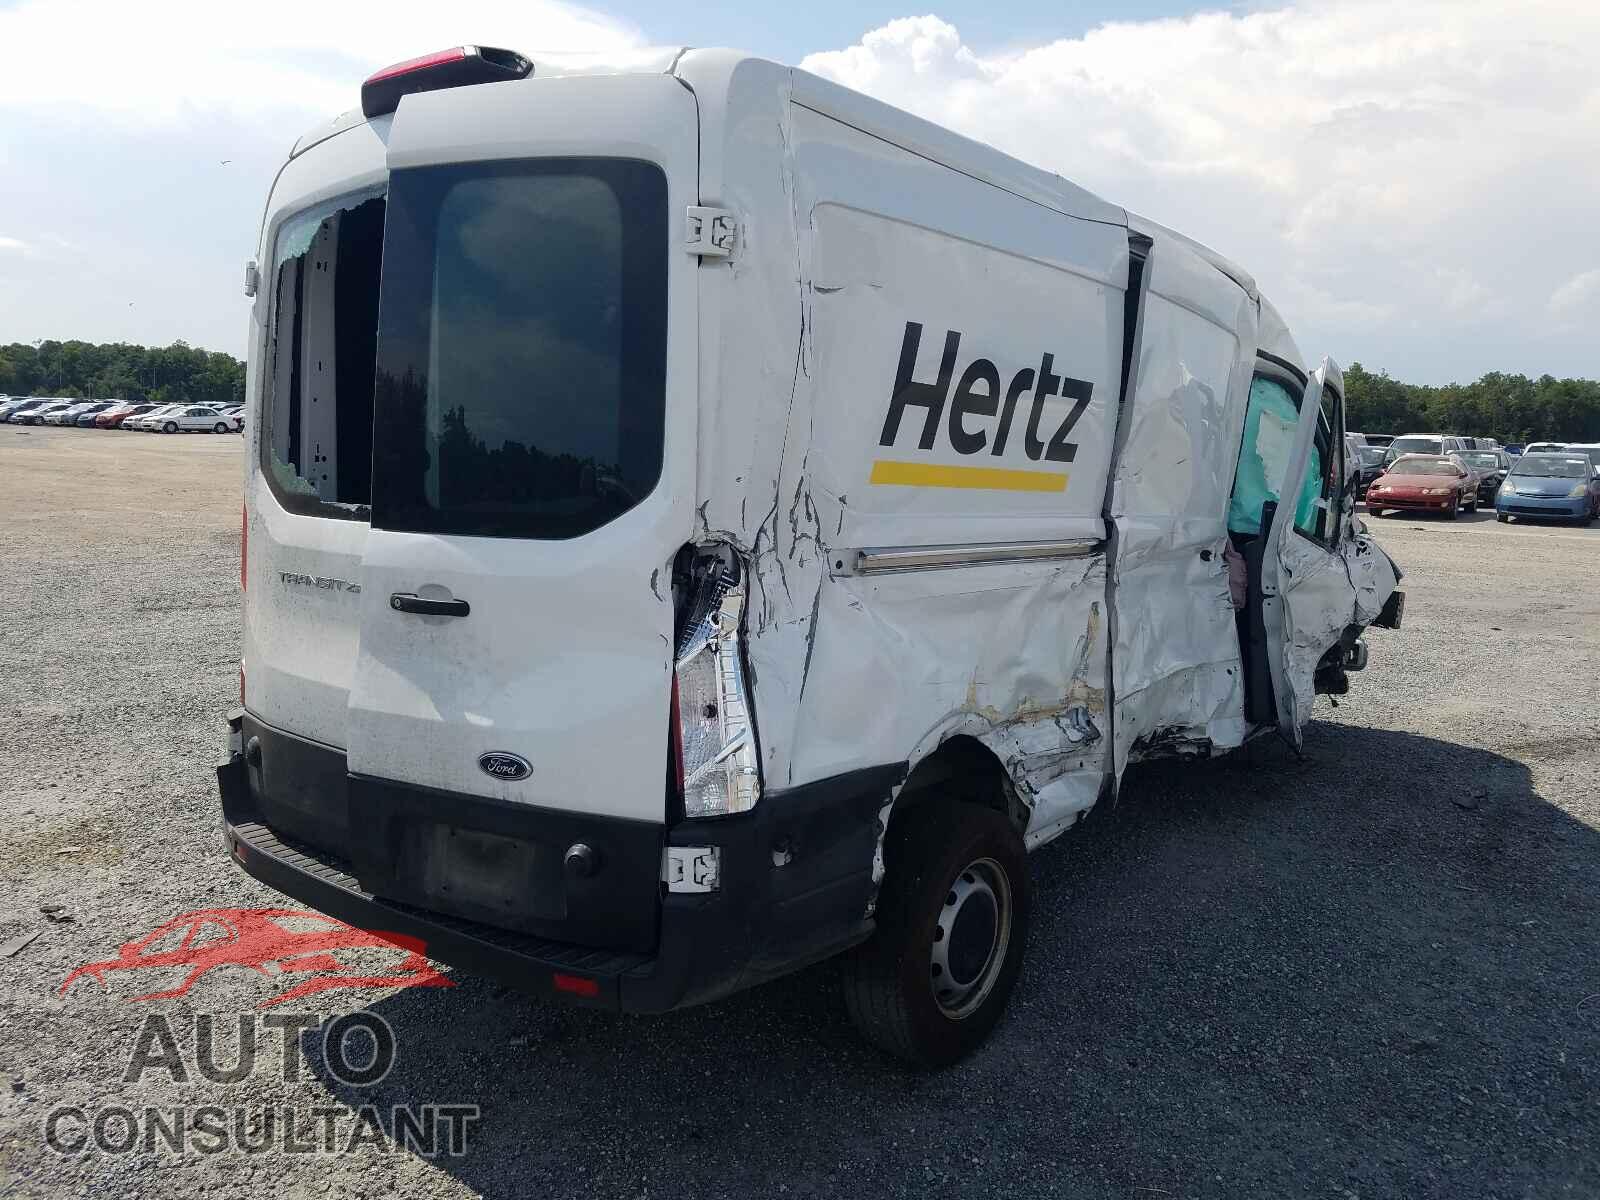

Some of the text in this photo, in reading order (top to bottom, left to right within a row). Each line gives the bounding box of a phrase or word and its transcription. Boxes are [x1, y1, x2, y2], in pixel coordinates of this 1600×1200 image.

[879, 321, 1094, 463] Hertz
[279, 570, 345, 592] TRANSIT
[487, 757, 518, 775] Ford
